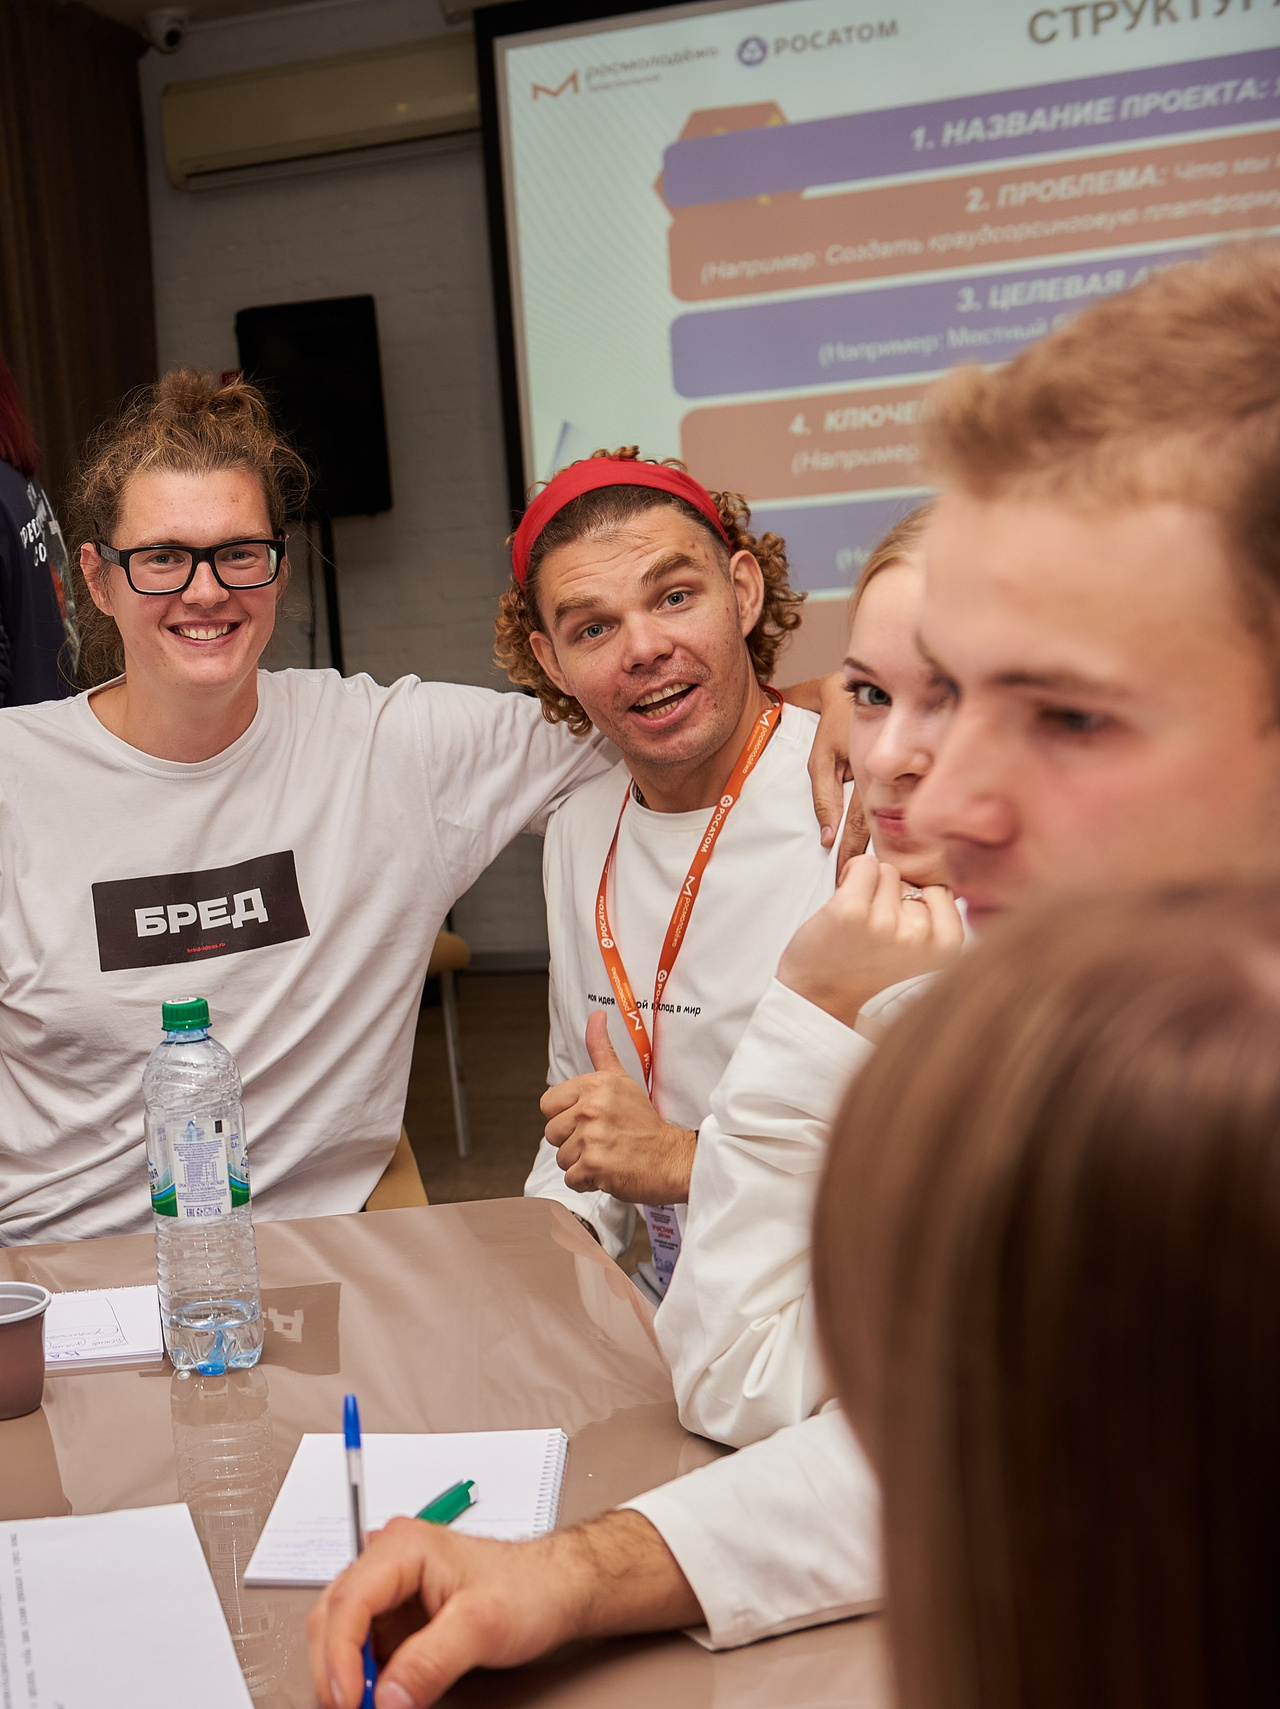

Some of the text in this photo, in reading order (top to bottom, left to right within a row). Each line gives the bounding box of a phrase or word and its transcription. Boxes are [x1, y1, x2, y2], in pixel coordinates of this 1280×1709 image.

[774, 19, 899, 56] РОСАТОМ
[911, 77, 1268, 150] 1. НАЗВАНИЕ ПРОЕКТА:
[966, 186, 990, 213] 2.
[996, 163, 1170, 208] ПРОБЛЕМА:
[825, 238, 924, 266] Создать
[956, 286, 981, 312] 3.
[987, 268, 1125, 311] ЦЕЛЕВАЯ
[788, 413, 812, 437] 4.
[700, 807, 726, 853] РОСАТОМ
[134, 888, 269, 937] БРЕД
[600, 895, 610, 938] РОСАТОМ
[598, 996, 615, 1006] идея
[636, 999, 648, 1010] ой
[676, 1005, 682, 1013] в
[683, 1006, 701, 1017] мир
